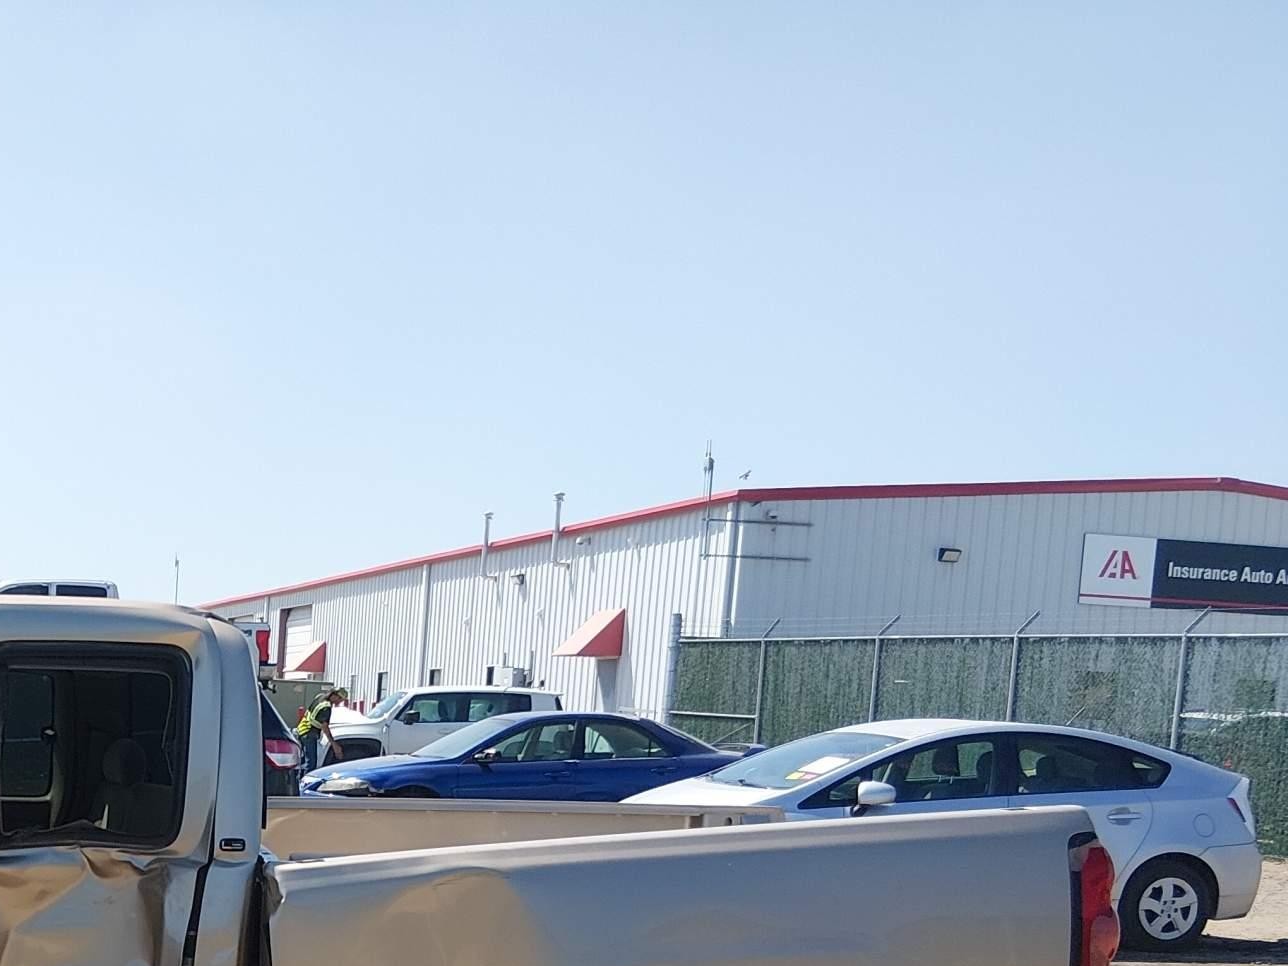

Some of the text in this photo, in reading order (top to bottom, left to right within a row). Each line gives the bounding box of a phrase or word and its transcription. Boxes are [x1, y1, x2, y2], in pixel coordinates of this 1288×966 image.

[1167, 561, 1238, 582] Insurance
[1240, 566, 1274, 584] Auto
[221, 840, 243, 849] LS
